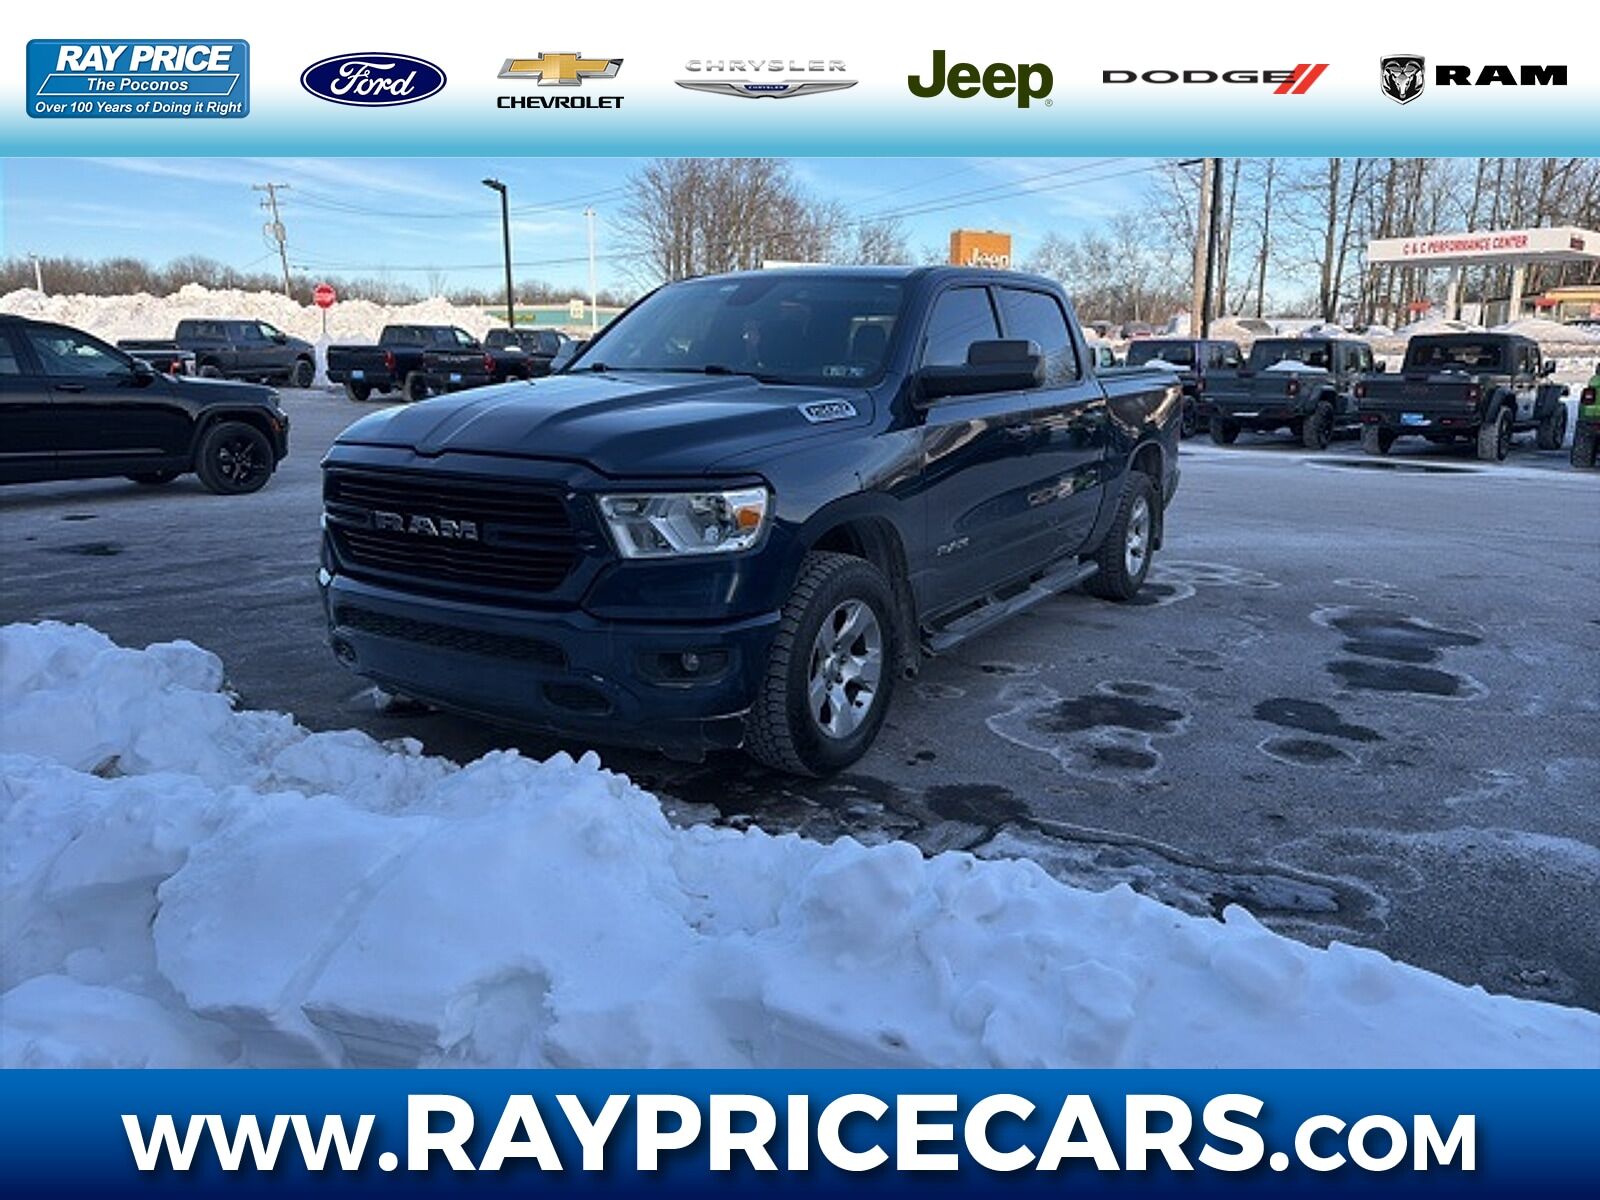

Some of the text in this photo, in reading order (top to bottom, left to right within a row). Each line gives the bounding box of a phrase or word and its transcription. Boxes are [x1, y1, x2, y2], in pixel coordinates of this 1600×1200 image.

[1493, 235, 1528, 249] CENTER
[967, 247, 1009, 269] Jeep
[374, 510, 479, 541] RAM
